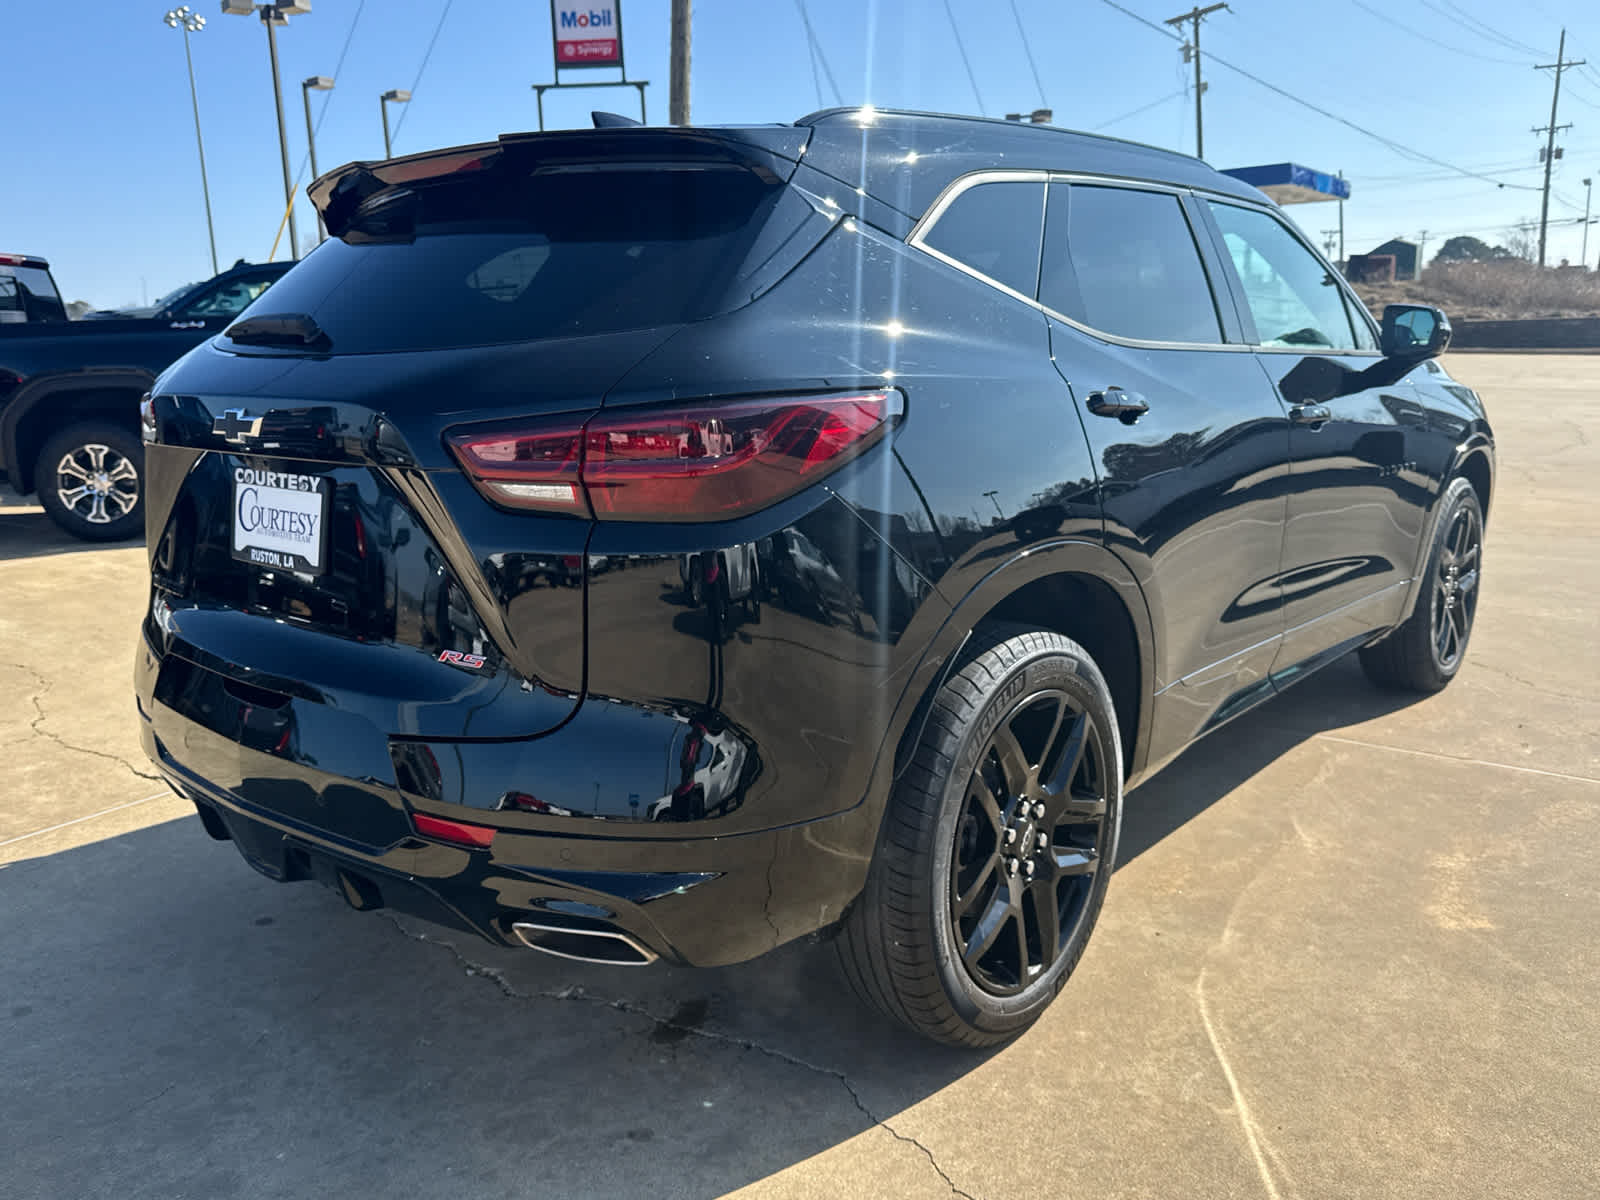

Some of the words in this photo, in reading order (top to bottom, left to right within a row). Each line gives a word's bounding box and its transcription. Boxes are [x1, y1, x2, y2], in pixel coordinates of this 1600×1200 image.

[561, 10, 612, 28] Mobil
[235, 468, 321, 493] COURTESY
[250, 549, 282, 567] RUSTON,
[283, 555, 295, 568] LA
[438, 649, 487, 668] RS
